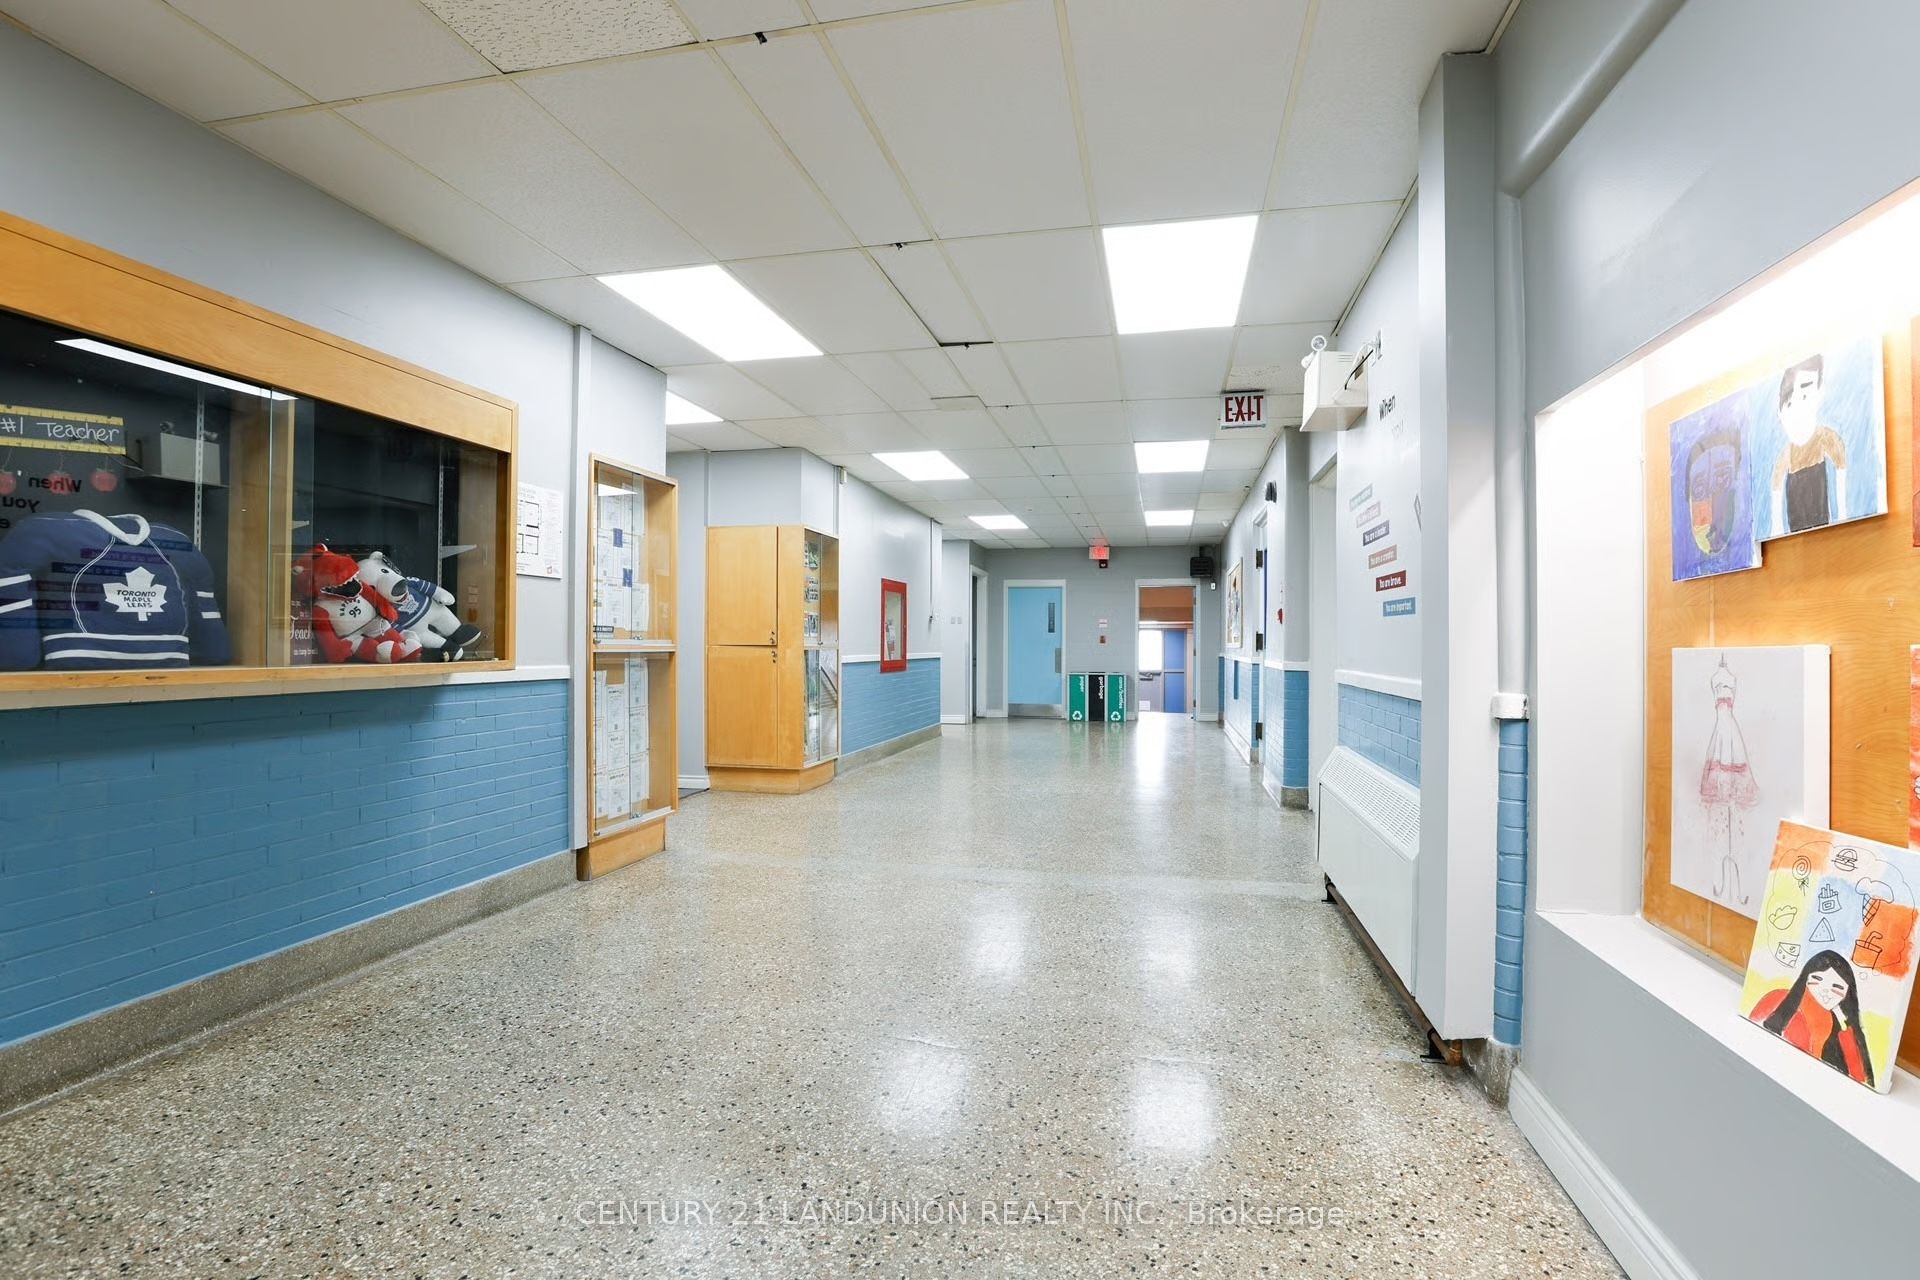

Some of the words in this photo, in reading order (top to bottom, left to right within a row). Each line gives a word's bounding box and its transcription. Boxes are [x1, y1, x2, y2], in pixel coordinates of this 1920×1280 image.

[1225, 395, 1264, 422] EXIT
[0, 416, 23, 435] #1
[36, 421, 120, 442] Teacher
[349, 606, 362, 618] 95
